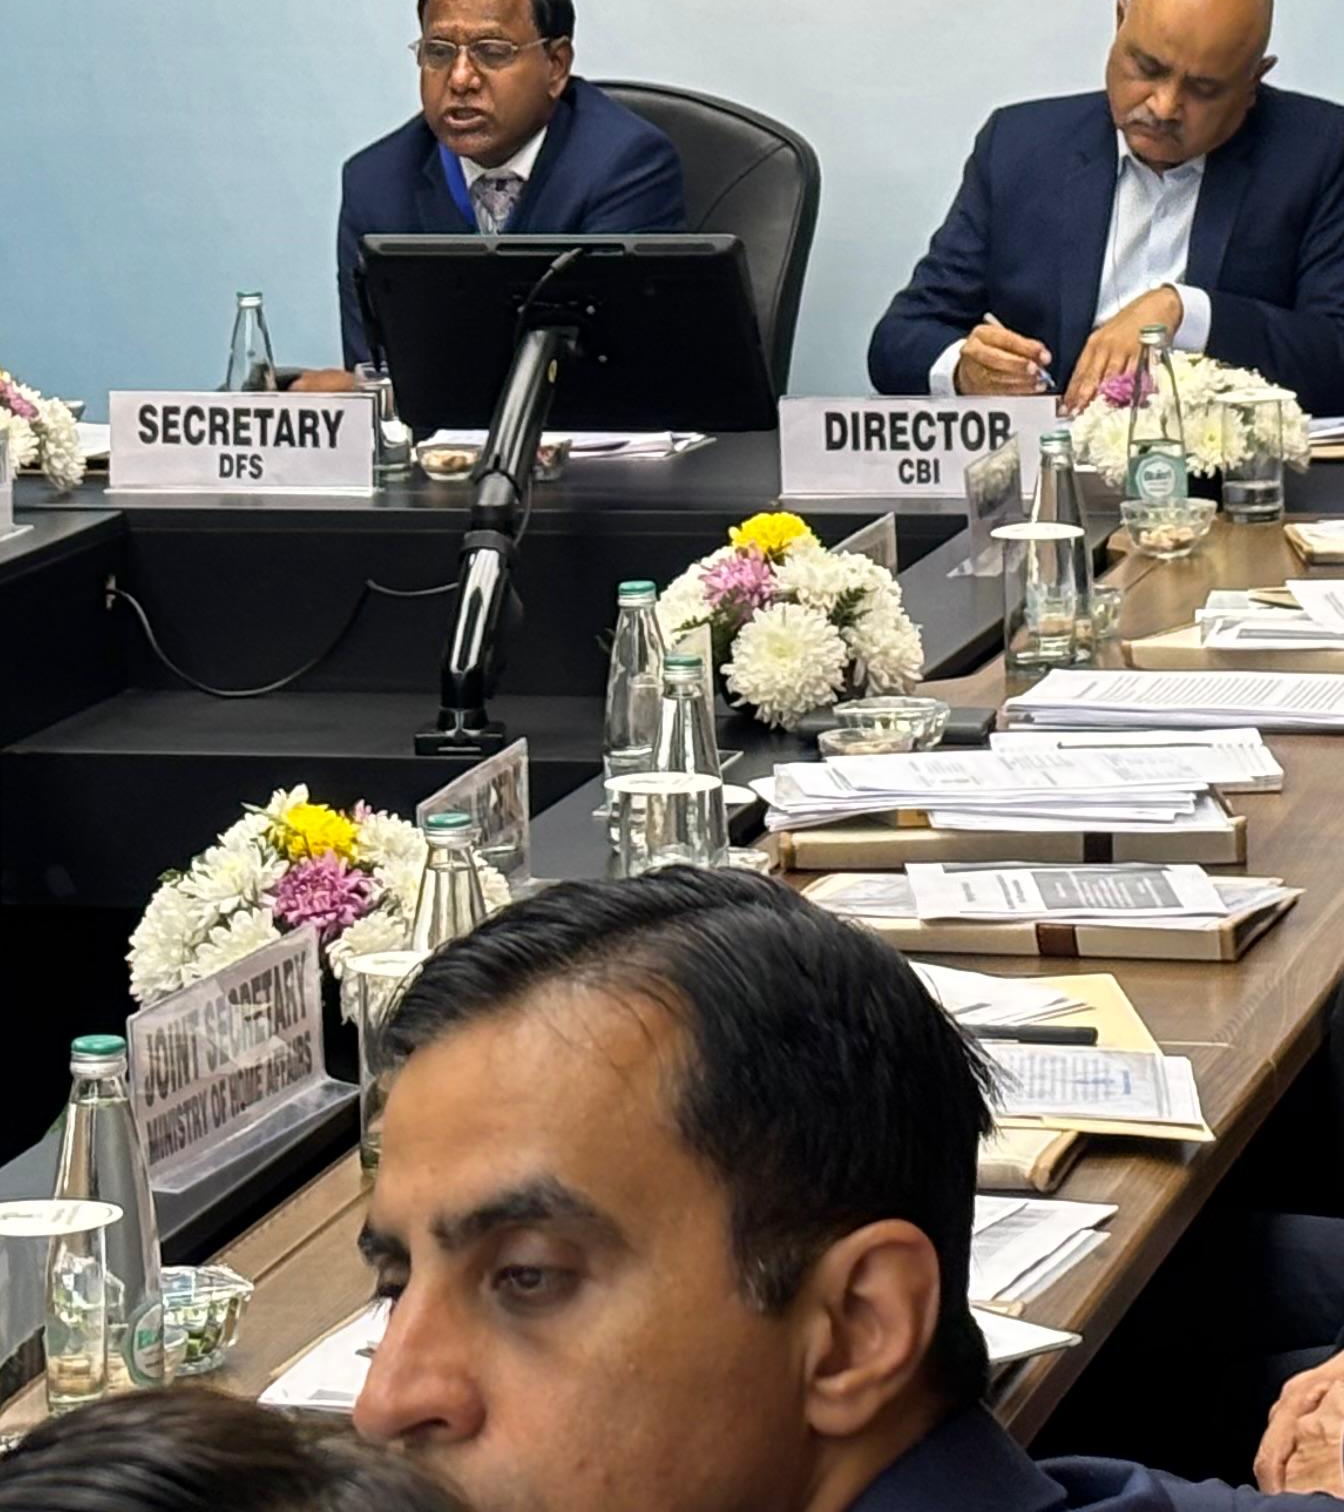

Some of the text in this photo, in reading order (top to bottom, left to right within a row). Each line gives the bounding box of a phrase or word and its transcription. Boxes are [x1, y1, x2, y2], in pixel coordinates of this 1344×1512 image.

[139, 405, 343, 448] SECRETARY
[825, 411, 1010, 451] DIRECTOR
[220, 454, 262, 479] DFS
[899, 459, 939, 484] CBI
[144, 1009, 200, 1107] JOINT
[146, 1090, 207, 1166] MINISTRY
[211, 1079, 226, 1128] OF
